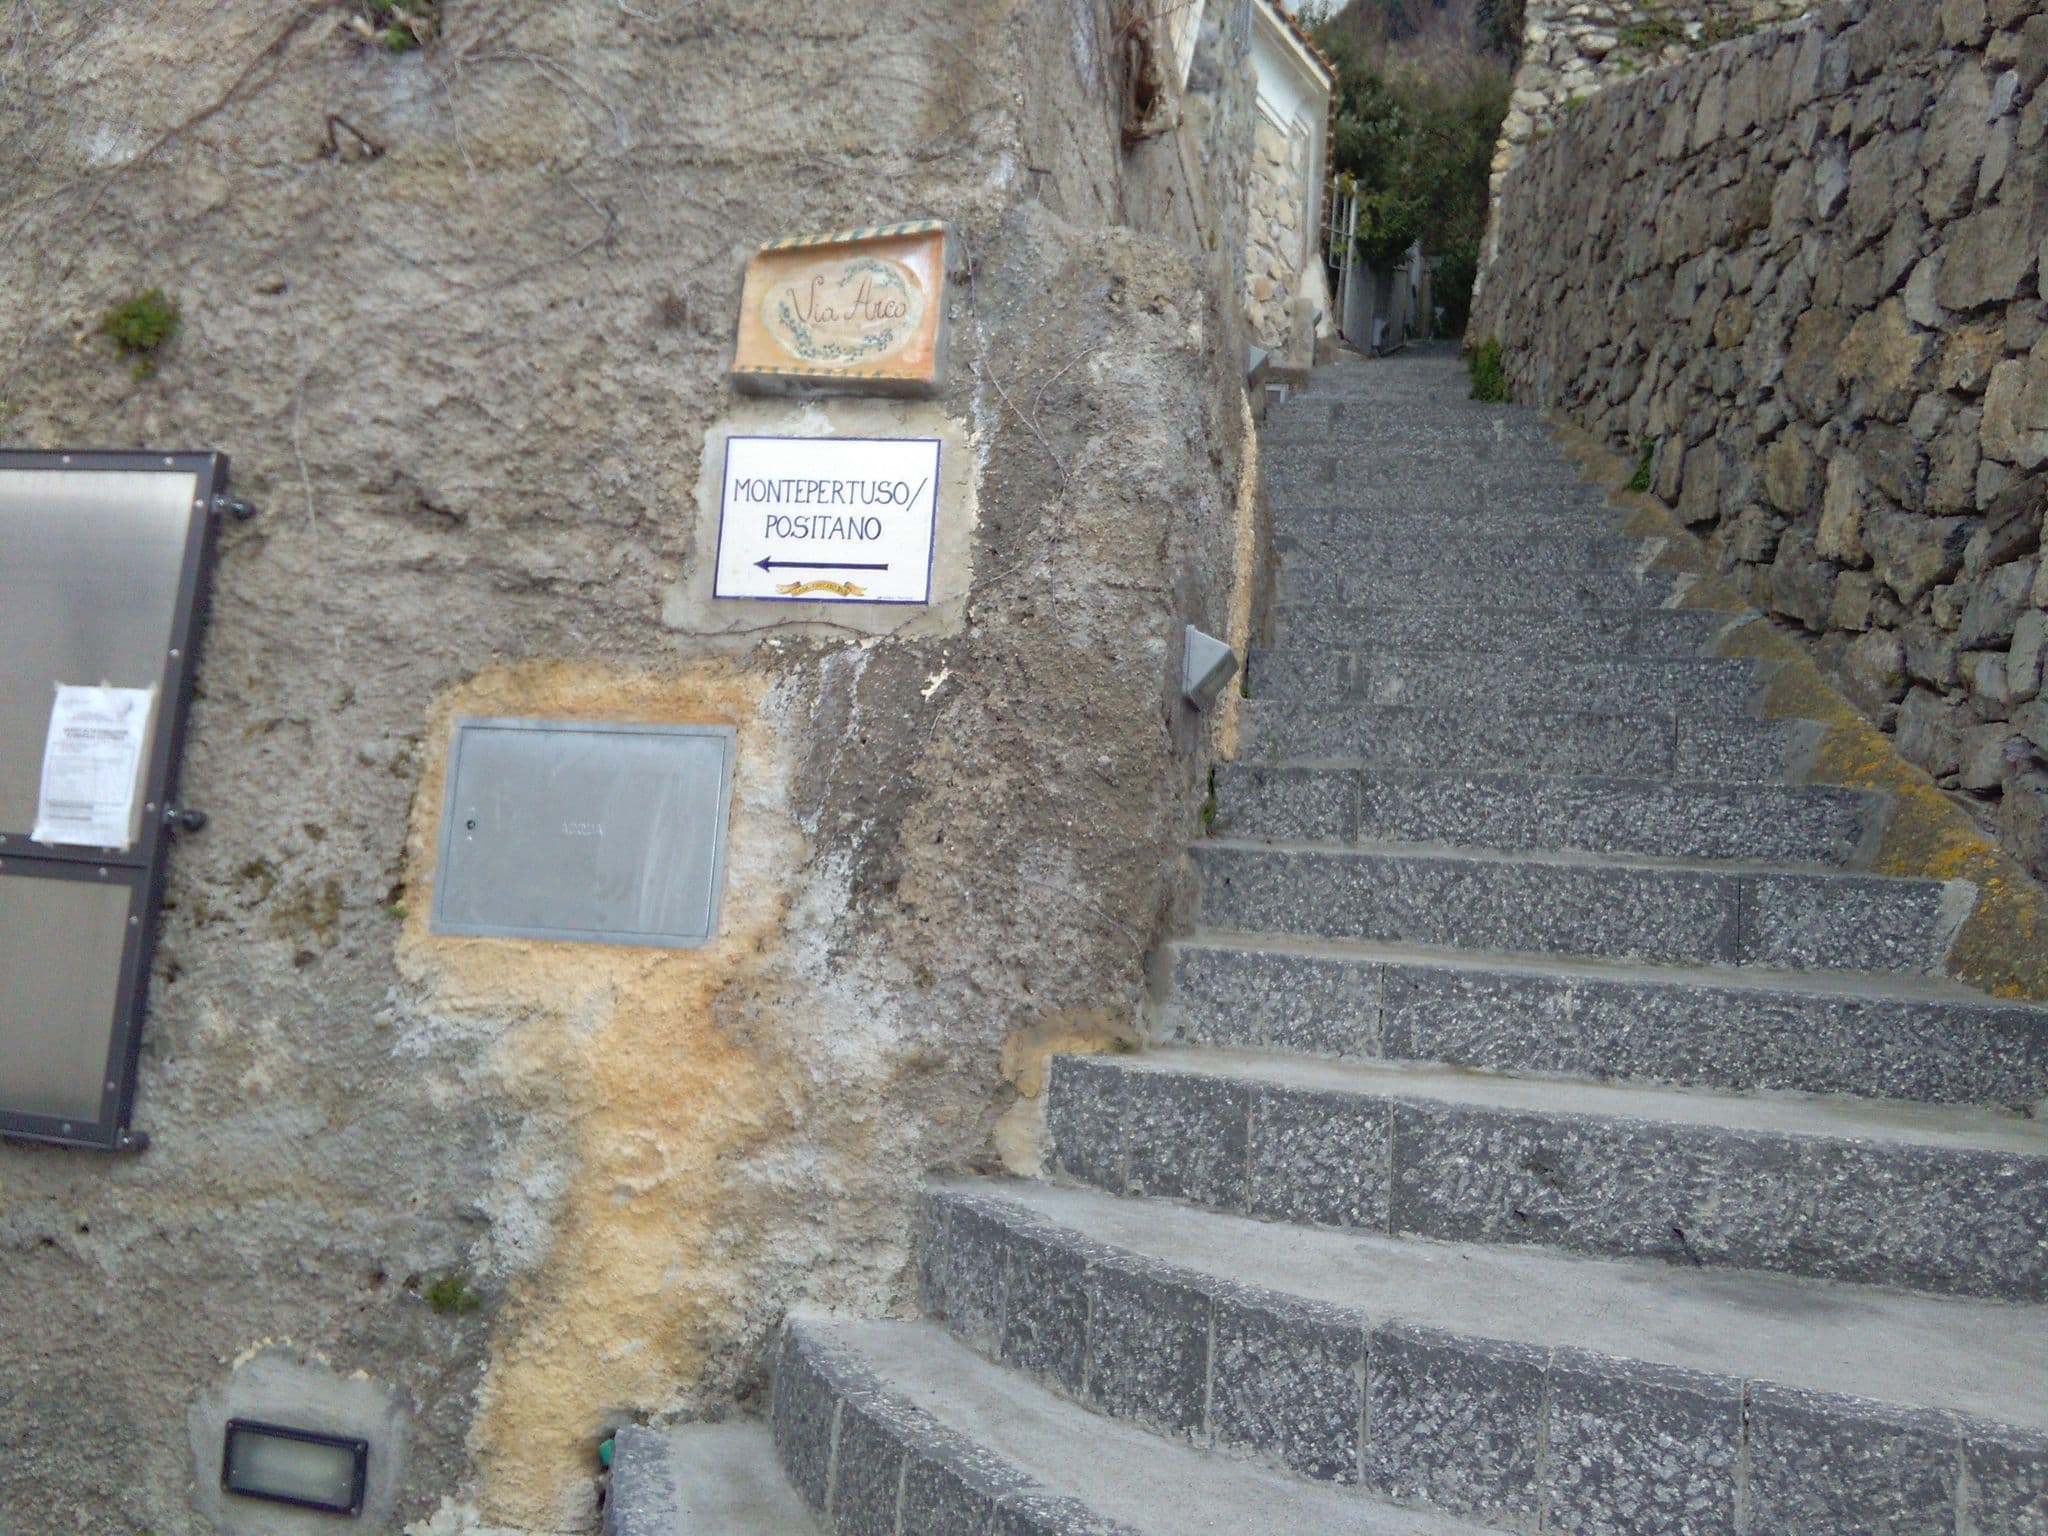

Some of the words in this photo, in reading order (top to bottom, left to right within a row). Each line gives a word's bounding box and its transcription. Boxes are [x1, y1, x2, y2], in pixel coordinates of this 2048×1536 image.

[786, 275, 840, 322] Via
[843, 276, 906, 321] Arco
[733, 477, 928, 512] MONTEPERTUSO/
[764, 514, 882, 541] POSITANO
